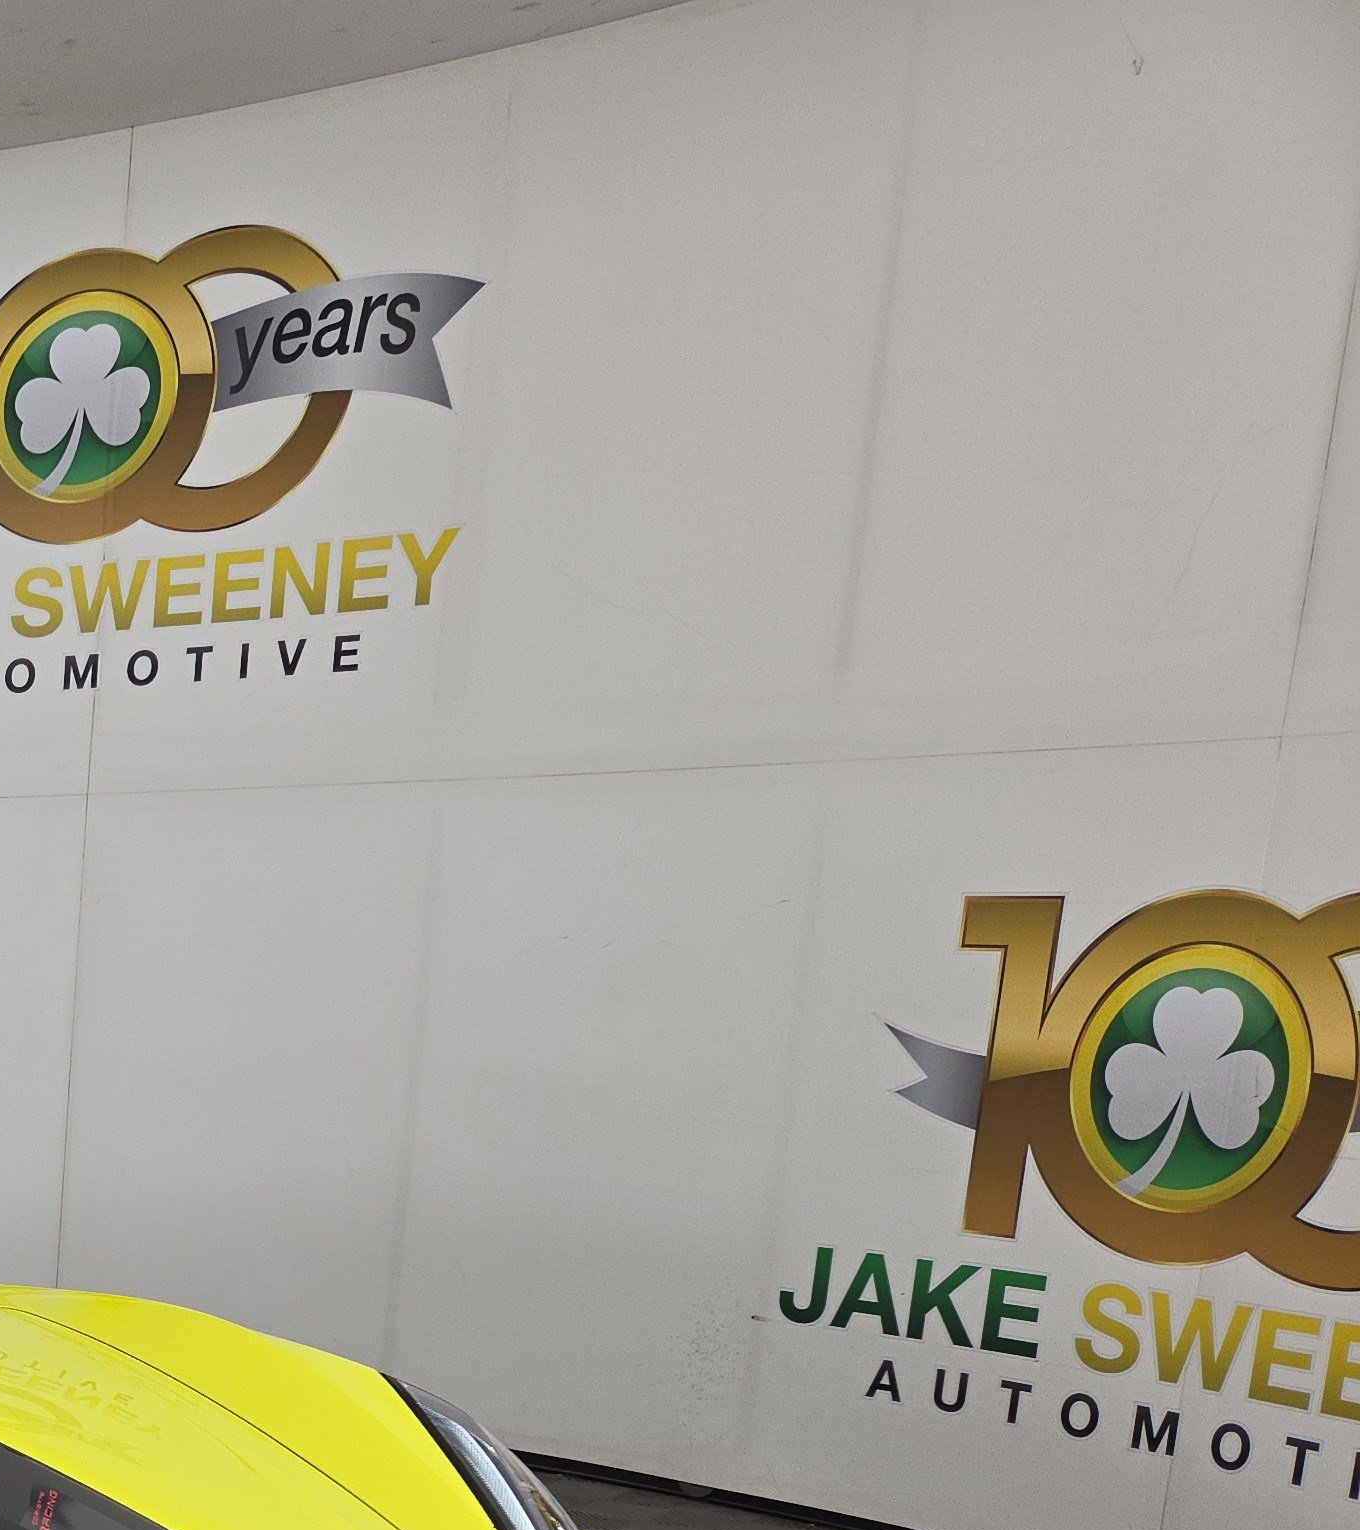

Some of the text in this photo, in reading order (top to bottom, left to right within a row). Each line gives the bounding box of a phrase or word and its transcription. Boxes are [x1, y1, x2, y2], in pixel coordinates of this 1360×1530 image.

[230, 290, 420, 395] years
[10, 527, 461, 639] SWEENEY
[778, 1247, 1048, 1359] JAKE
